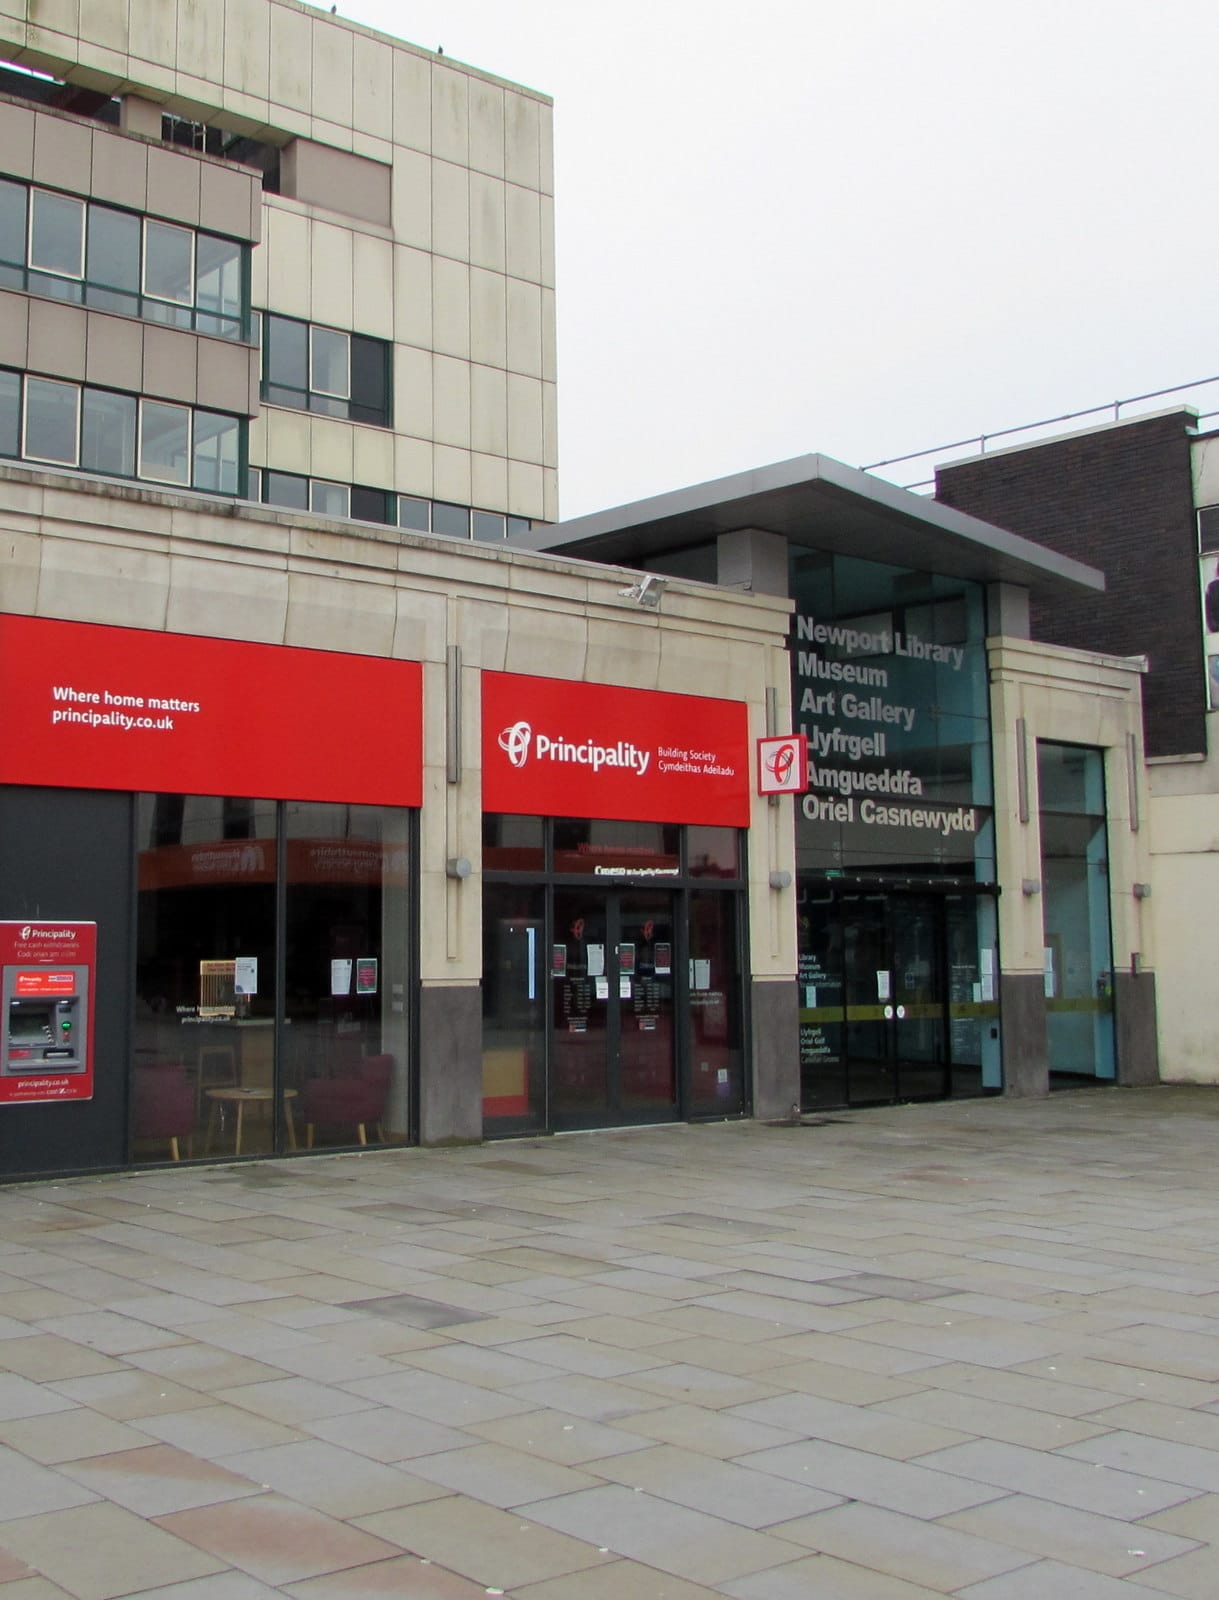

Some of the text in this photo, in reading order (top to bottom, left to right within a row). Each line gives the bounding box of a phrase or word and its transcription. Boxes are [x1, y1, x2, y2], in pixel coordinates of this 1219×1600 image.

[798, 615, 963, 670] Newport Library
[798, 651, 888, 688] Museum
[53, 687, 200, 712] Where home matters
[800, 687, 916, 731] Art Gallery
[53, 708, 173, 729] principality.co.uk
[537, 735, 650, 775] Principality
[658, 747, 716, 763] Building Society
[658, 760, 735, 776] Cymdeithas Adeiladu
[807, 762, 923, 796] Amgueddfa
[802, 794, 976, 836] Oriel Casnewydd
[32, 929, 76, 941] Principality
